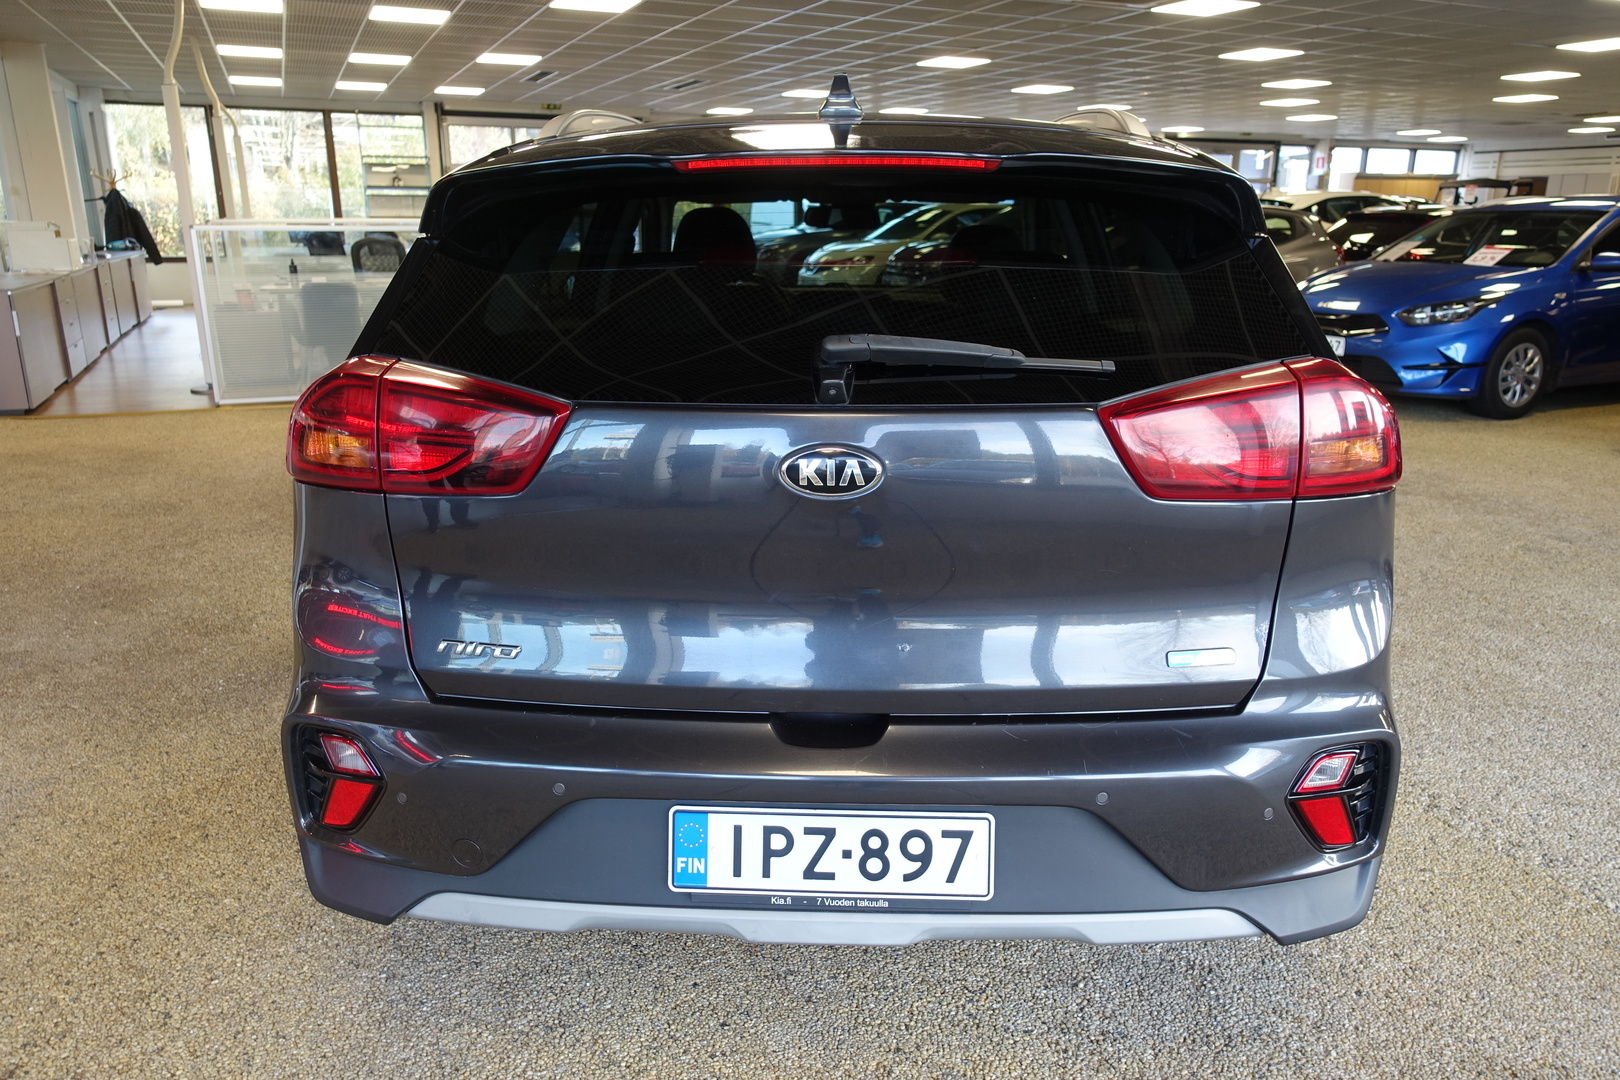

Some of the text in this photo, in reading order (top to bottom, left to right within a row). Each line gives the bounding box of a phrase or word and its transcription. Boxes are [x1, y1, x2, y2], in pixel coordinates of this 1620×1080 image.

[798, 458, 866, 487] KIA
[676, 857, 705, 874] FIN
[771, 896, 792, 905] Kia.fi
[816, 898, 822, 906] 7
[823, 897, 855, 907] Vuoden
[857, 899, 889, 908] takuulla
